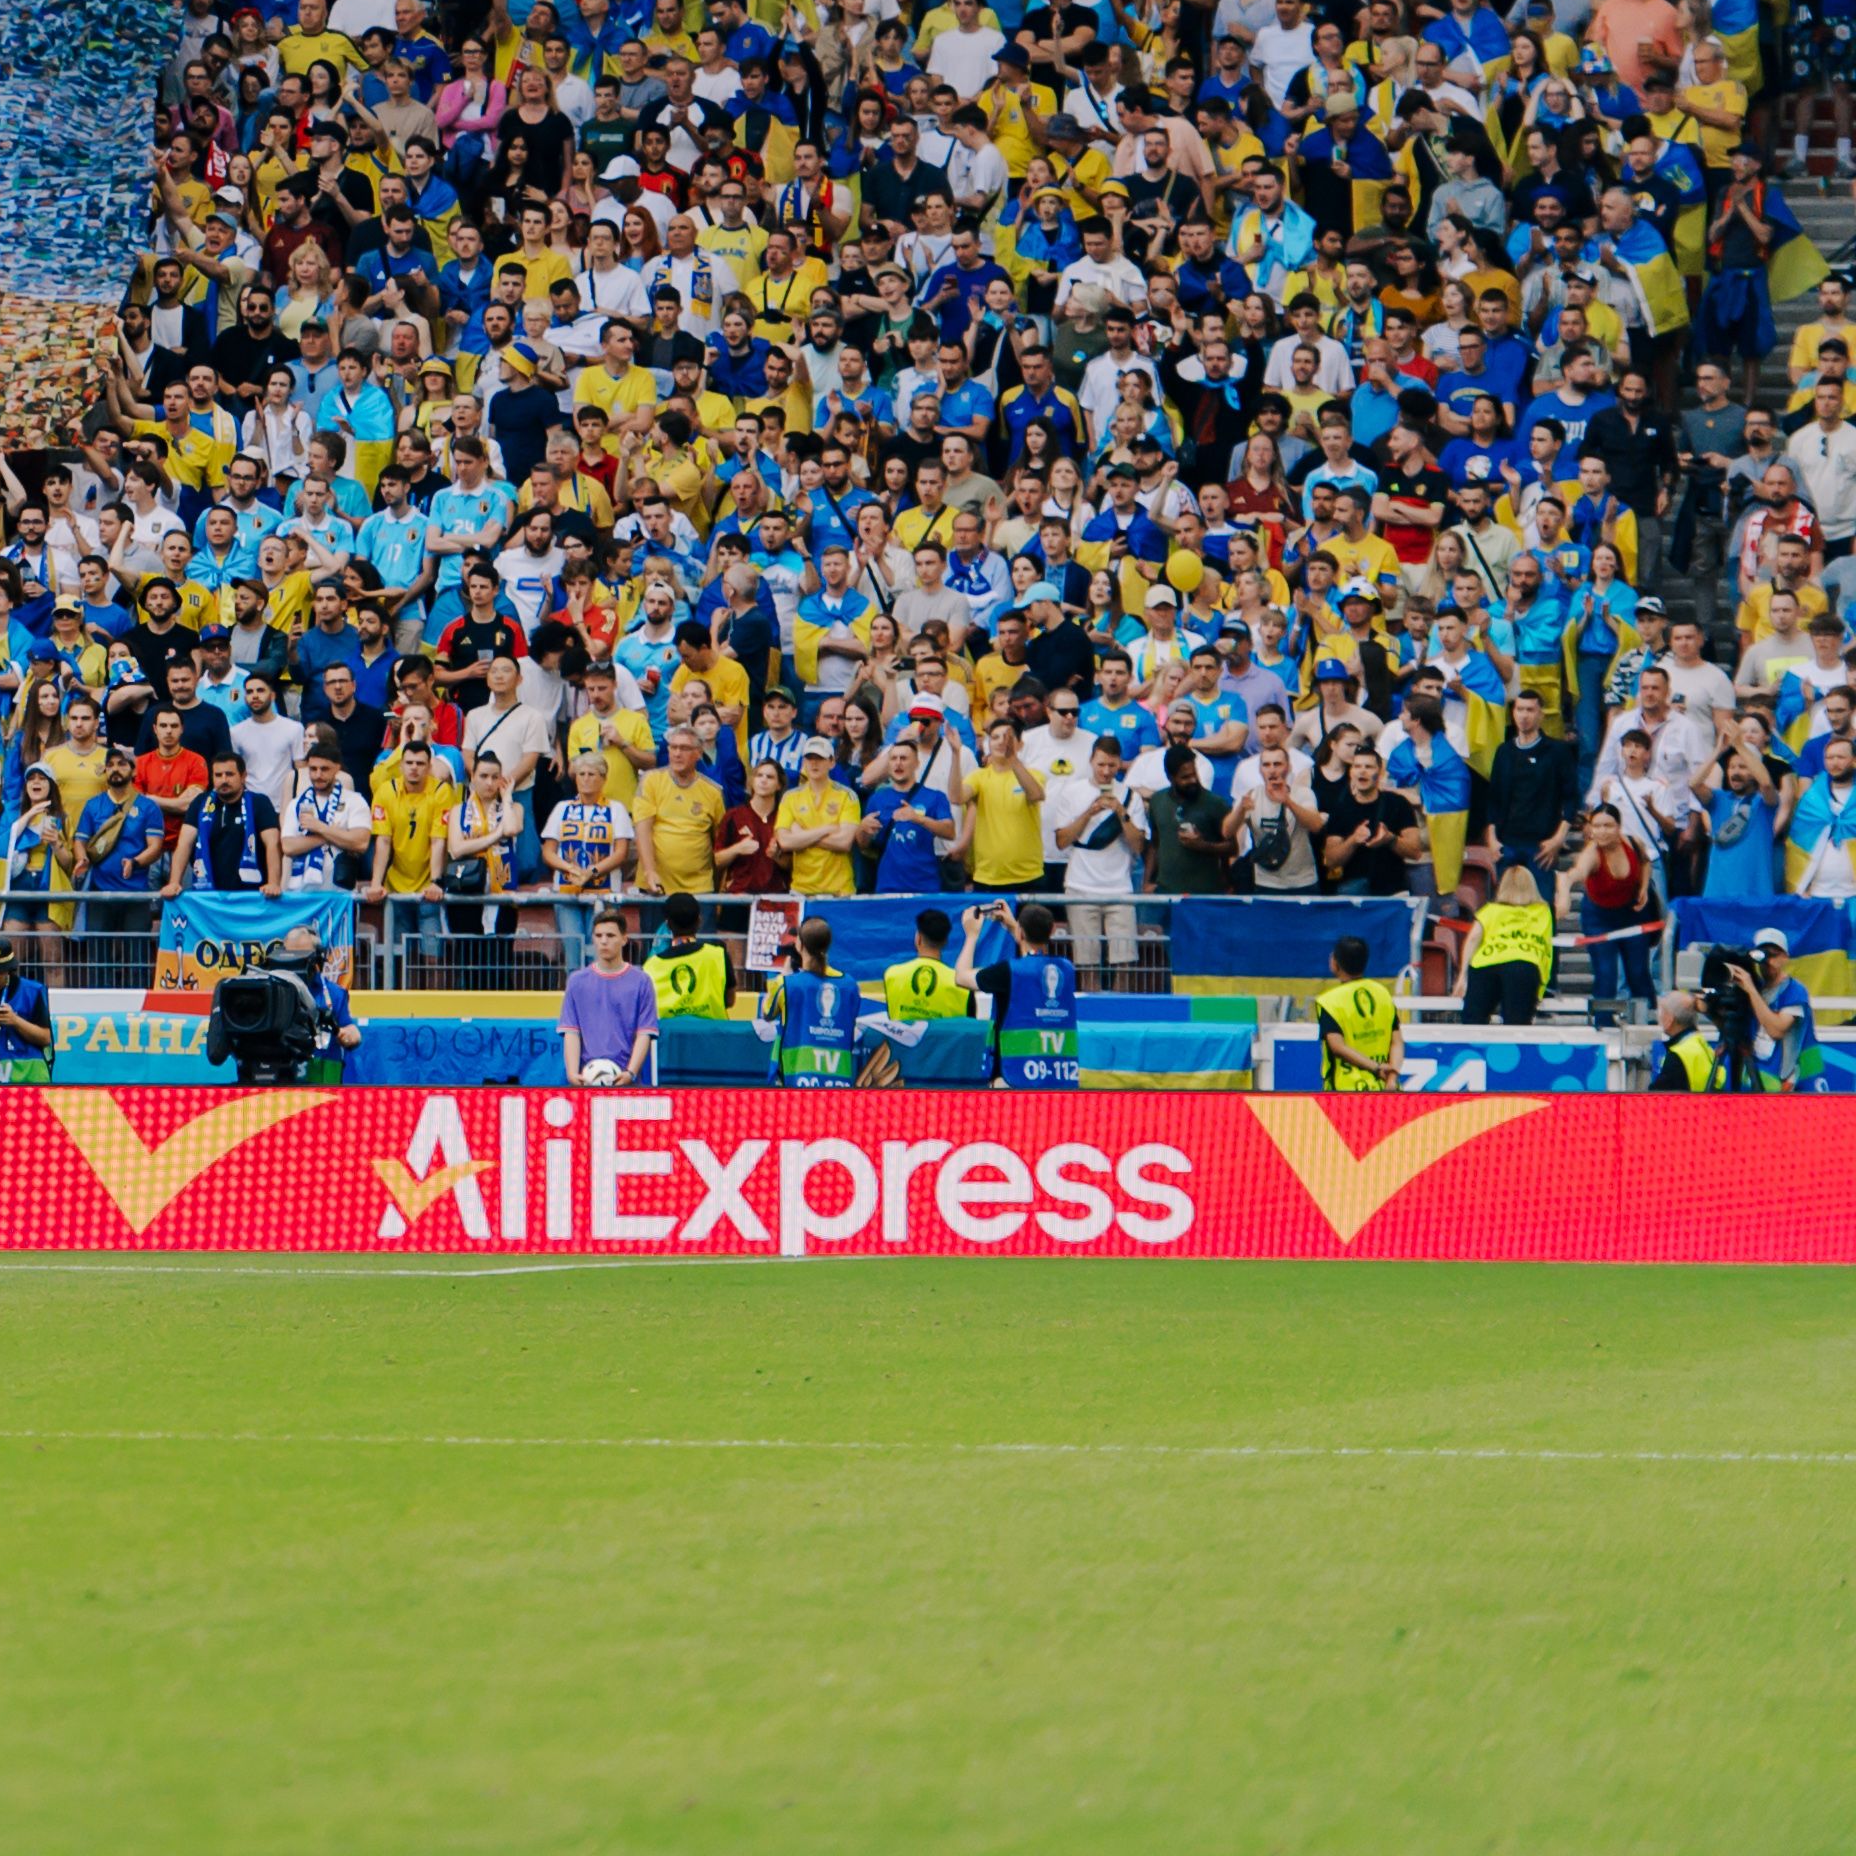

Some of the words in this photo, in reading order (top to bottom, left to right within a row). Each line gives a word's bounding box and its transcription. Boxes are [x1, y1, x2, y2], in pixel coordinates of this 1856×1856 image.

[1040, 1032, 1065, 1054] TV
[813, 1048, 840, 1073] TV
[1023, 1060, 1079, 1081] 09-112
[376, 1095, 1194, 1256] AliExpress
